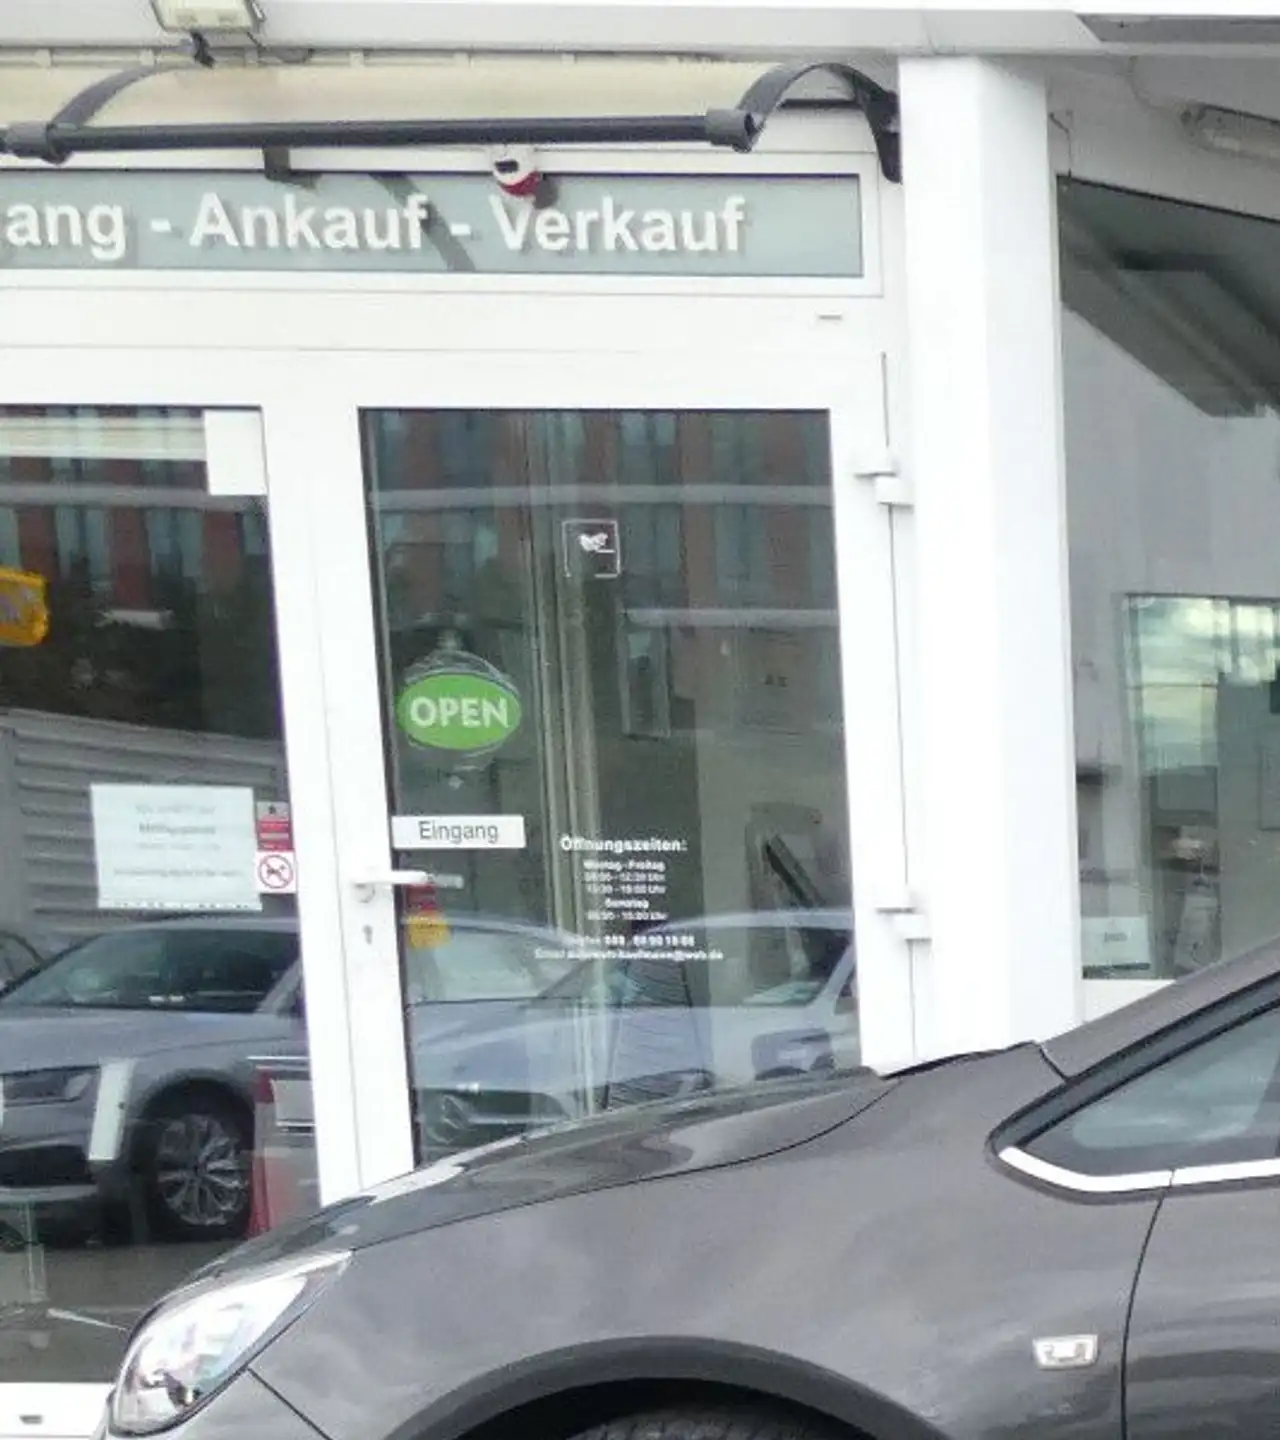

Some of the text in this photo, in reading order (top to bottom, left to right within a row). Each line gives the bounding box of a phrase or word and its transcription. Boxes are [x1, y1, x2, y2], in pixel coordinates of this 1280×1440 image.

[189, 192, 429, 250] Ankauf
[488, 194, 746, 252] Verkauf
[409, 696, 509, 728] OPEN
[418, 820, 499, 845] Eingang
